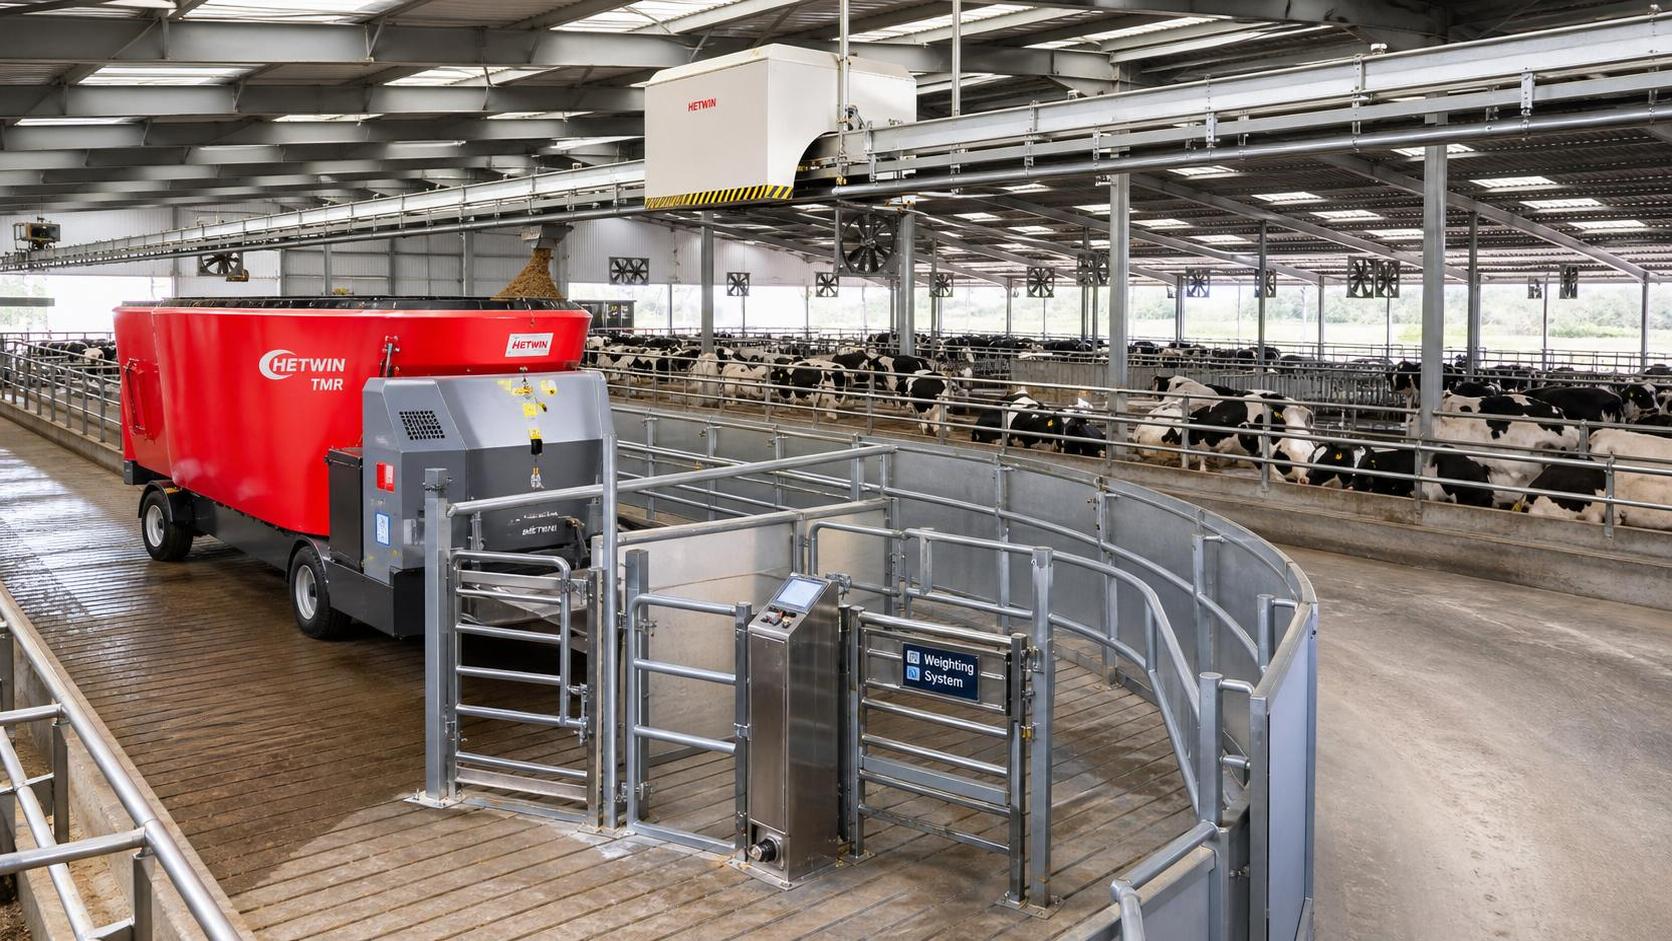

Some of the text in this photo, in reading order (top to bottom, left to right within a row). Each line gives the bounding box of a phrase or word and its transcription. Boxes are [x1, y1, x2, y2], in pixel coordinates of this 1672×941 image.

[688, 98, 716, 112] HETWIN
[512, 340, 548, 349] HETWIN
[272, 358, 346, 372] HETWIN
[311, 378, 344, 391] TMR
[924, 653, 974, 676] Weighting
[924, 670, 963, 688] System
